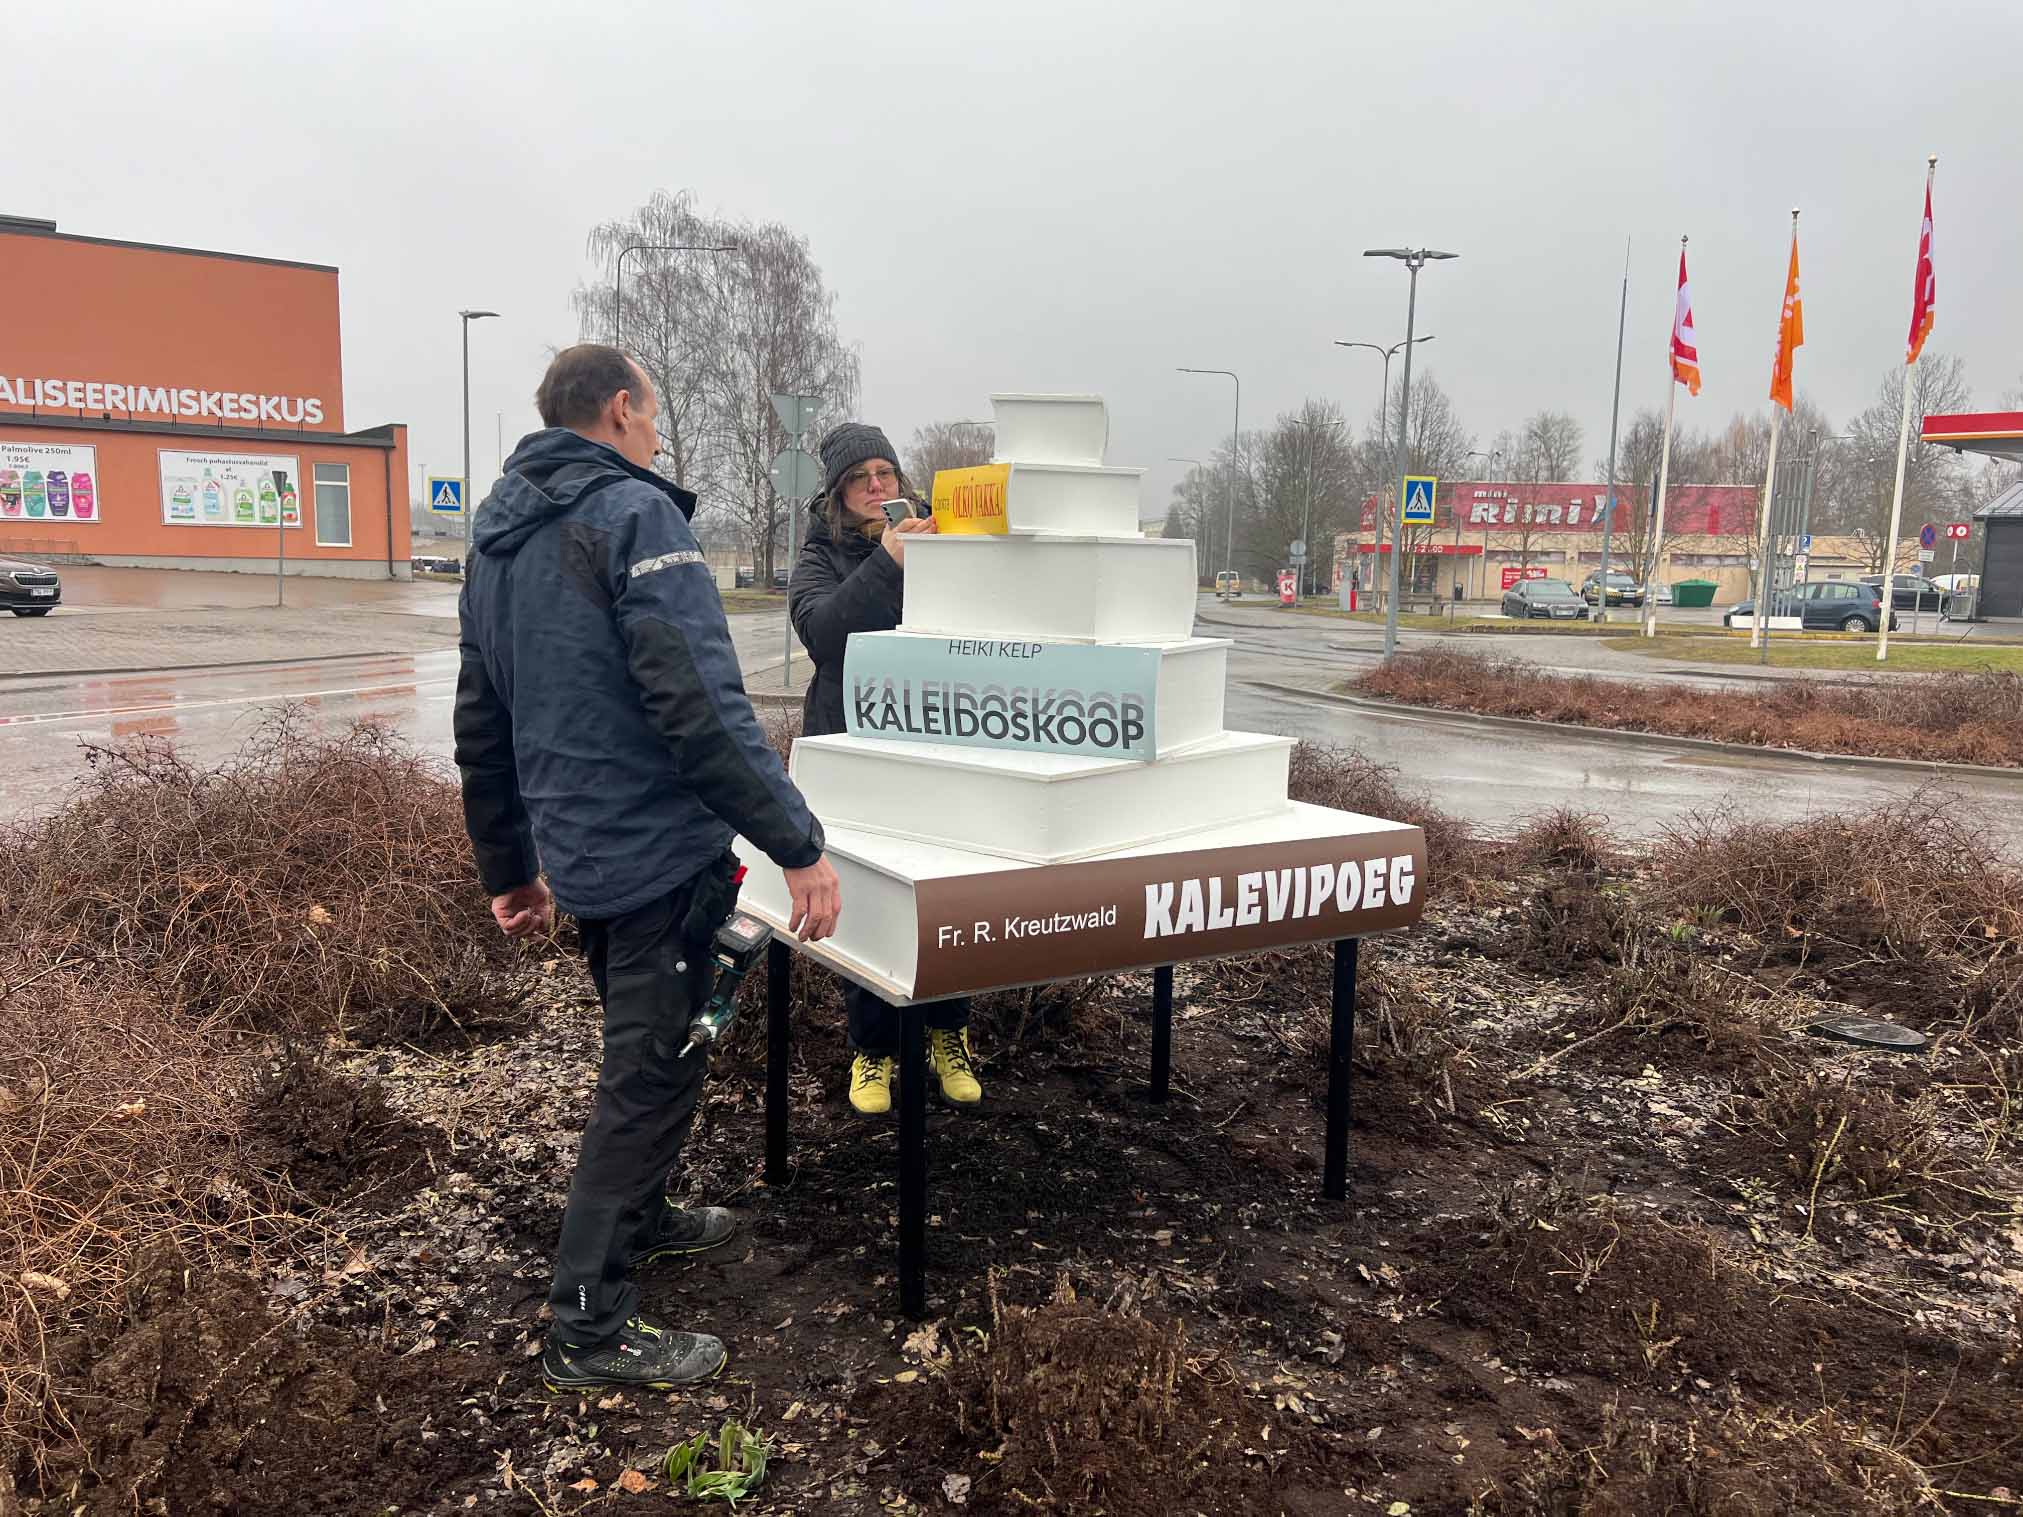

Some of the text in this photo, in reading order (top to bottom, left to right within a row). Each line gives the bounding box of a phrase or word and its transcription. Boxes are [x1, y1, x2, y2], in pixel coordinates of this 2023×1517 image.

[1, 445, 71, 455] Palmolive 250ml
[948, 640, 1042, 659] HEIKI KELP
[854, 700, 1144, 750] KALEIDOSKOOP
[1143, 855, 1415, 939] KALEVIPOEG
[937, 905, 1117, 949] Fr. R. Kreutzwald
